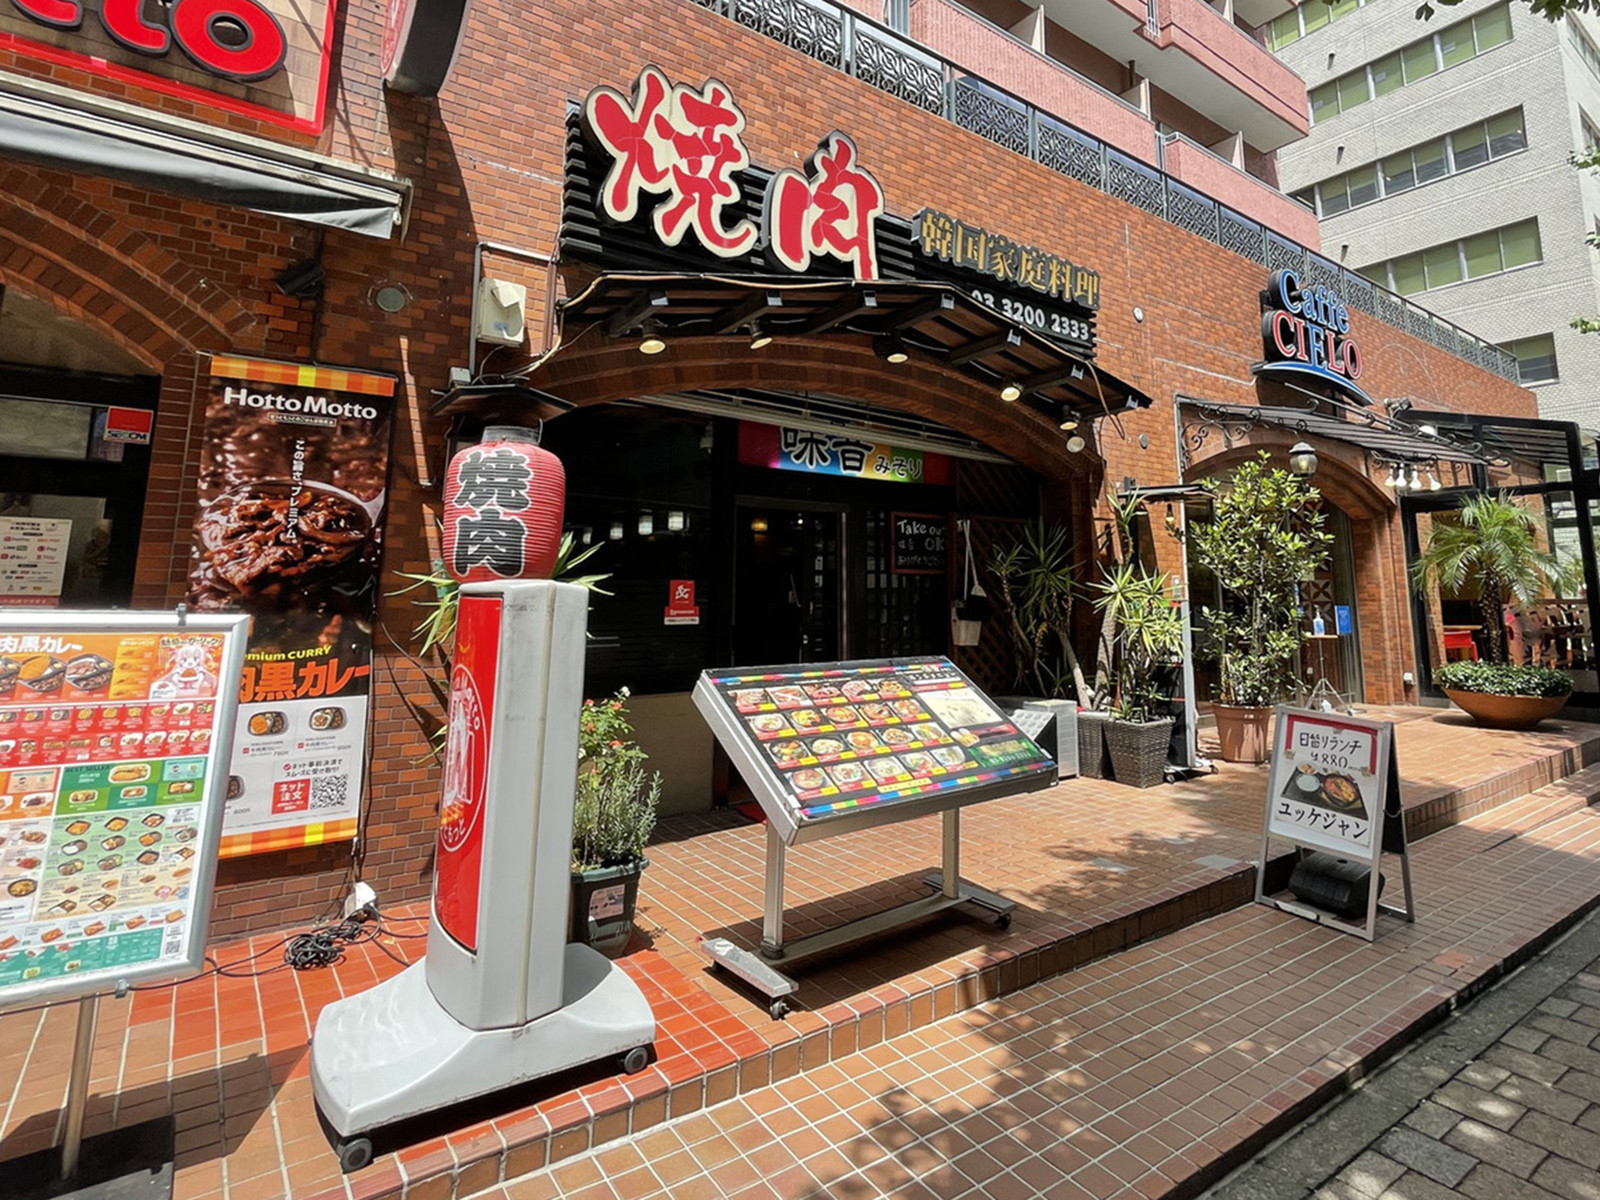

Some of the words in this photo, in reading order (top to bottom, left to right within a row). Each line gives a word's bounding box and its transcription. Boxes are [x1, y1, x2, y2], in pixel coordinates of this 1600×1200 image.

[580, 65, 885, 280] 焼肉
[922, 211, 1098, 306] 韓国家庭料理
[1001, 298, 1046, 328] 3200
[1051, 313, 1089, 341] 2333
[1273, 310, 1363, 379] CIELO
[223, 386, 302, 412] Hotto
[303, 395, 377, 419] Motto
[874, 455, 923, 479] みそり
[452, 448, 534, 578] 焼肉
[896, 519, 927, 535] Take
[924, 536, 945, 551] OK
[243, 651, 286, 661] mium
[287, 645, 332, 660] CURRY
[1278, 802, 1368, 839] ユッケジャン
